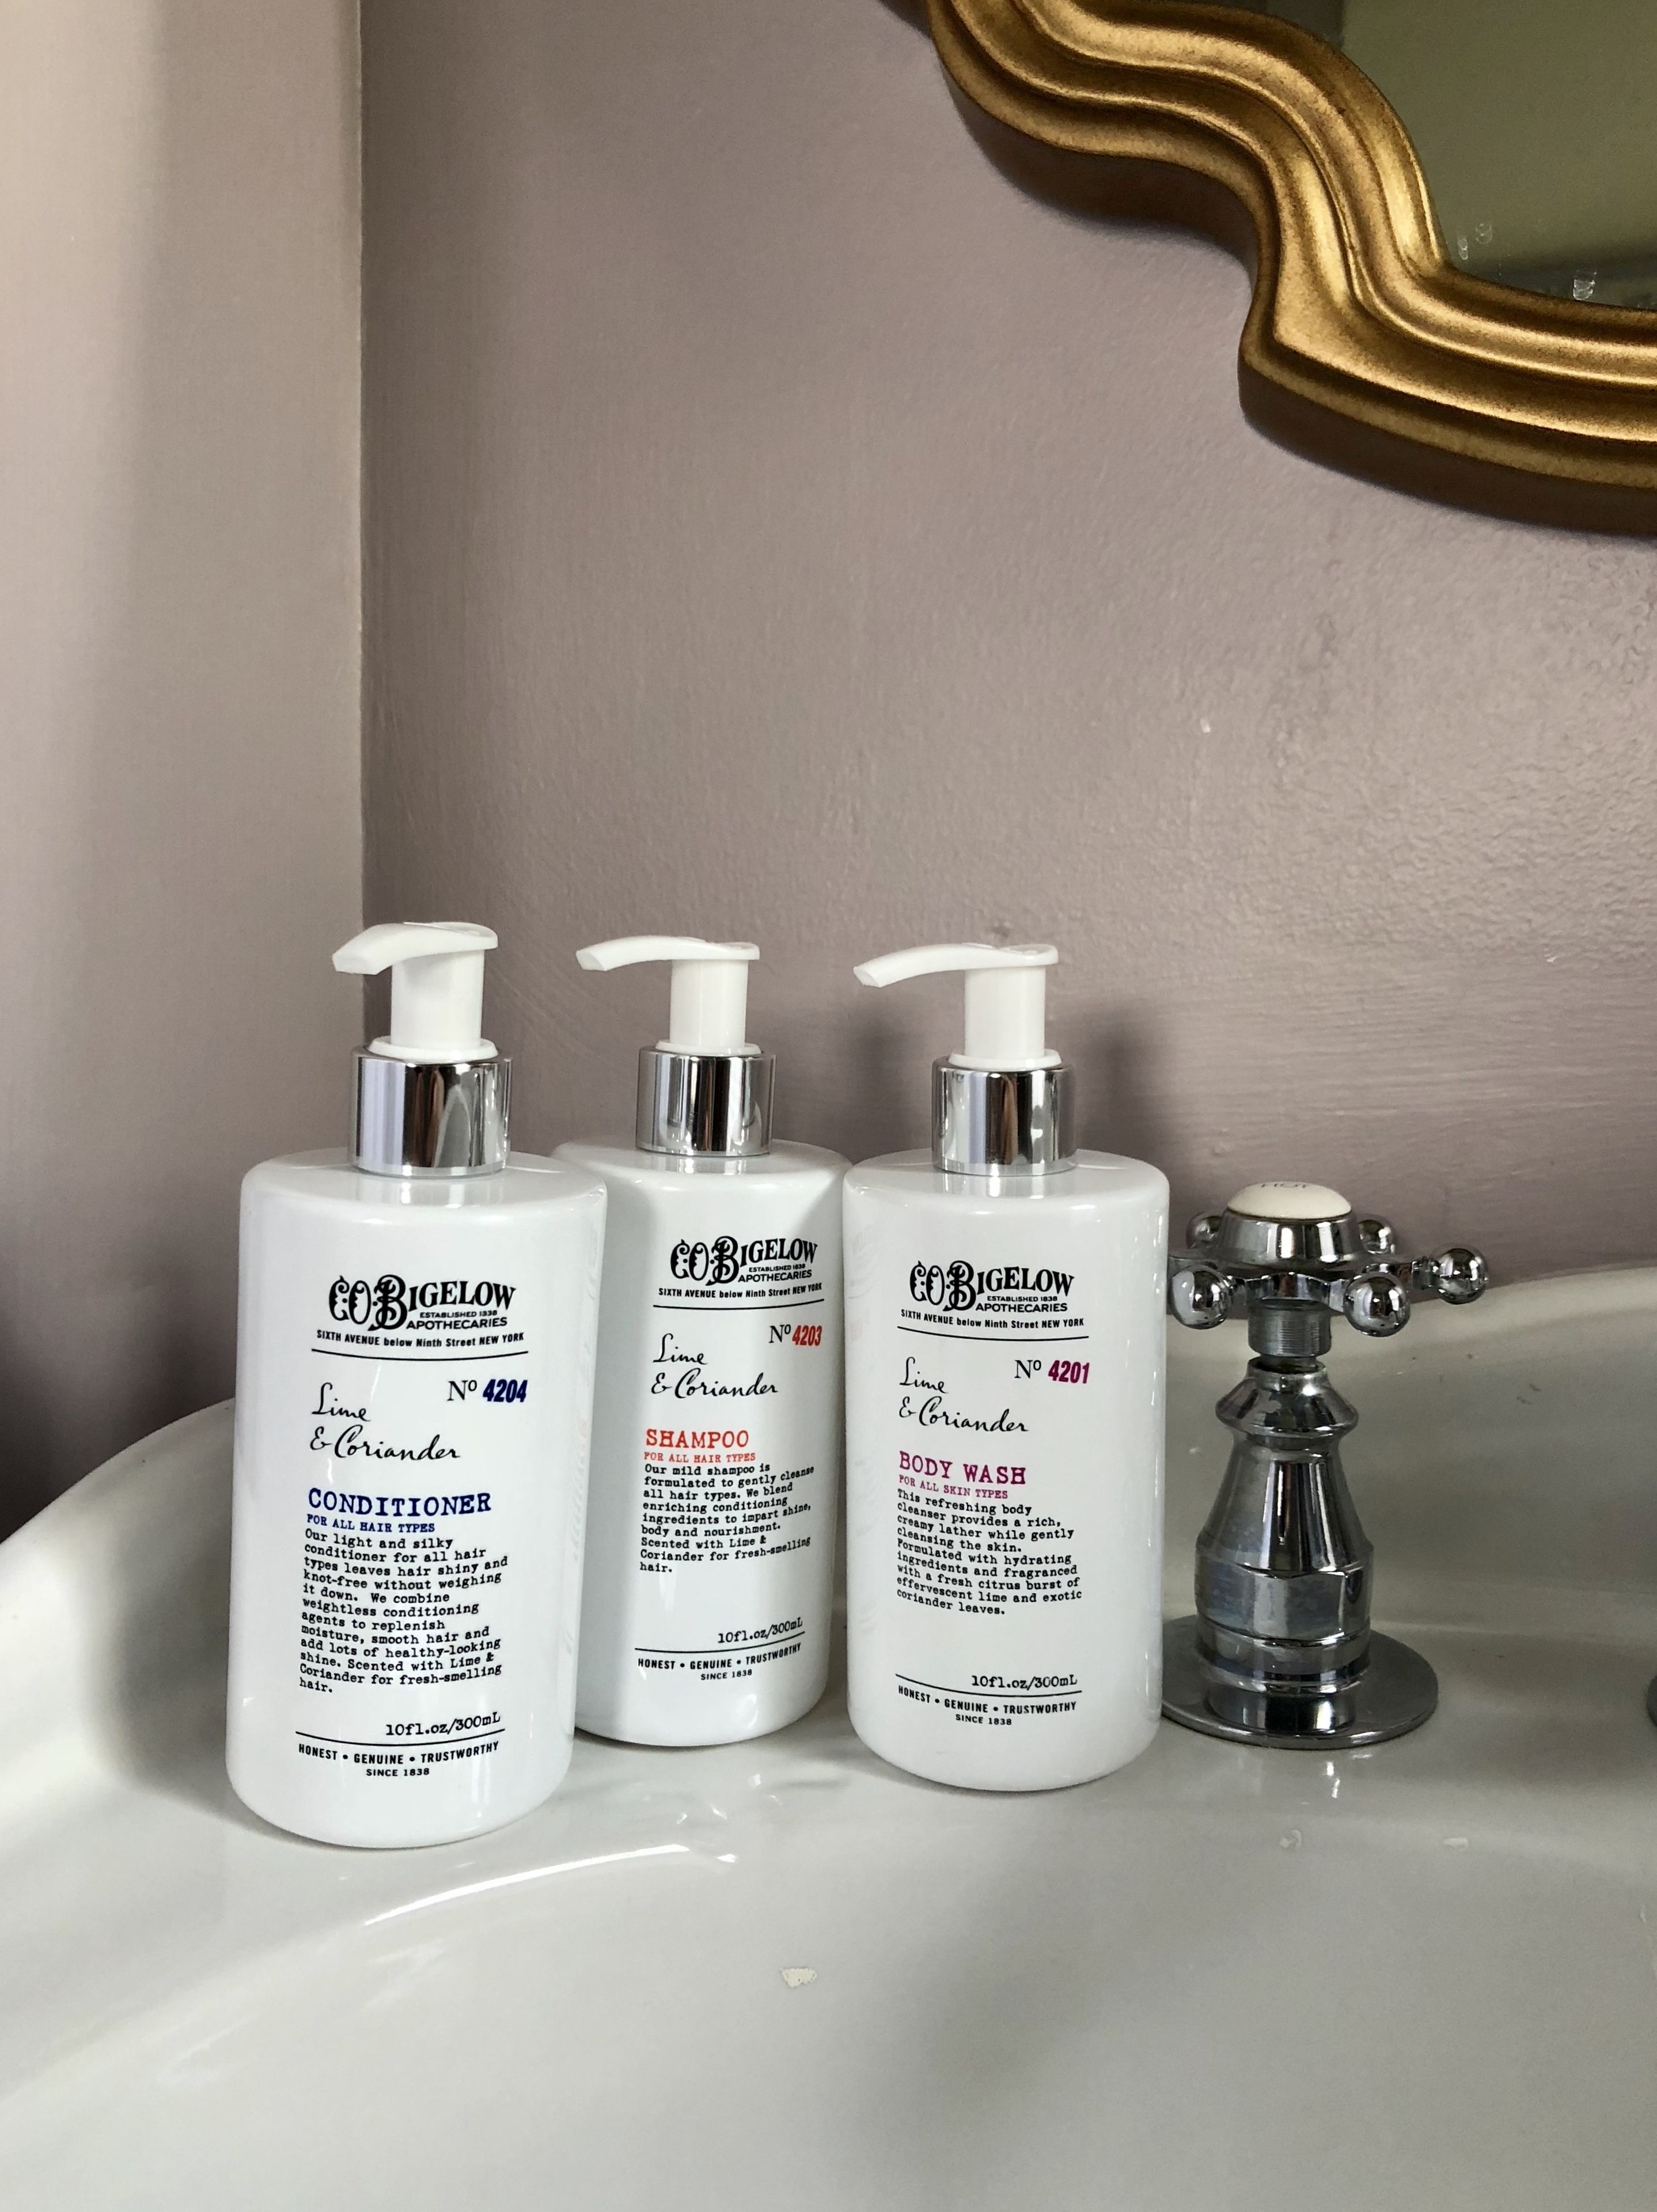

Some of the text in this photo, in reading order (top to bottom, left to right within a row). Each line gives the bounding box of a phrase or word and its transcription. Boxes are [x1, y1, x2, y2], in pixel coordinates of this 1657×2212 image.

[737, 1269, 812, 1283] APOTHECARIES
[975, 1302, 1068, 1313] APOTHECARIES
[405, 1316, 507, 1330] APOTHECARIES
[901, 1309, 1084, 1329] SIXTH AVENUE below Ninth Street NEW YORK
[317, 1329, 524, 1347] SIXTH AVENUE below Ninth Street NEW YORK
[792, 1325, 822, 1346] 4203
[653, 1333, 708, 1365] Lime
[899, 1357, 948, 1394] Lime
[1048, 1359, 1090, 1384] 4201
[482, 1378, 528, 1403] 4204
[651, 1368, 778, 1399] & Coriander
[311, 1382, 371, 1422] Lime
[899, 1396, 1029, 1432] & Coriander
[310, 1424, 460, 1461] & Coriander
[646, 1429, 749, 1449] SHAMPOO
[644, 1452, 756, 1463] FOR ALL HAIR TYPES
[900, 1450, 1026, 1485] BODY WASH
[645, 1463, 770, 1476] Our mild shampoo is
[643, 1482, 793, 1502] all hair types. We blend
[899, 1474, 1008, 1499] FOR ALL SKIN TYPES
[308, 1487, 491, 1517] CONDITIONER
[643, 1497, 788, 1514] enriching conditioning
[897, 1488, 1032, 1516] This refreshing body
[307, 1513, 435, 1533] FOR ALL HAIR TYPES
[897, 1502, 1061, 1527] cleanser provides a rich,
[305, 1528, 453, 1550] Our light and silky
[641, 1522, 780, 1537] body and nourishment.
[897, 1515, 1074, 1542] creamy lather while gently
[897, 1527, 1022, 1552] cleansing the skin.
[305, 1544, 486, 1563] conditioner for all hair
[897, 1539, 1072, 1567] Formulated with hydrating
[304, 1555, 508, 1577] types leaves hair shiny and
[897, 1551, 1078, 1580] ingredients and fragranced
[303, 1569, 502, 1590] knot-free without weighing
[897, 1565, 1080, 1590] with a fresh citrus burst of
[897, 1577, 1082, 1603] effervescent lime and exotic
[302, 1599, 479, 1618] weightless conditioning
[897, 1589, 1005, 1615] coriander leaves.
[302, 1612, 446, 1633] agents to replenish
[301, 1625, 490, 1645] moisture, smooth hair and
[300, 1652, 494, 1671] shine. Scented with Lime &
[638, 1642, 801, 1670] HONEST GENUINE TRUSTWORTHY
[300, 1663, 502, 1685] Coriander for fresh-smelling
[700, 1669, 752, 1680] SINCE 1838
[898, 1685, 1076, 1714] HONEST GENUINE TRUSTWORTHY
[955, 1714, 1012, 1725] SINCE 1838
[298, 1740, 499, 1764] HONEST GENUINE TRUSTWORTHY
[366, 1767, 430, 1777] SINCE 1838
